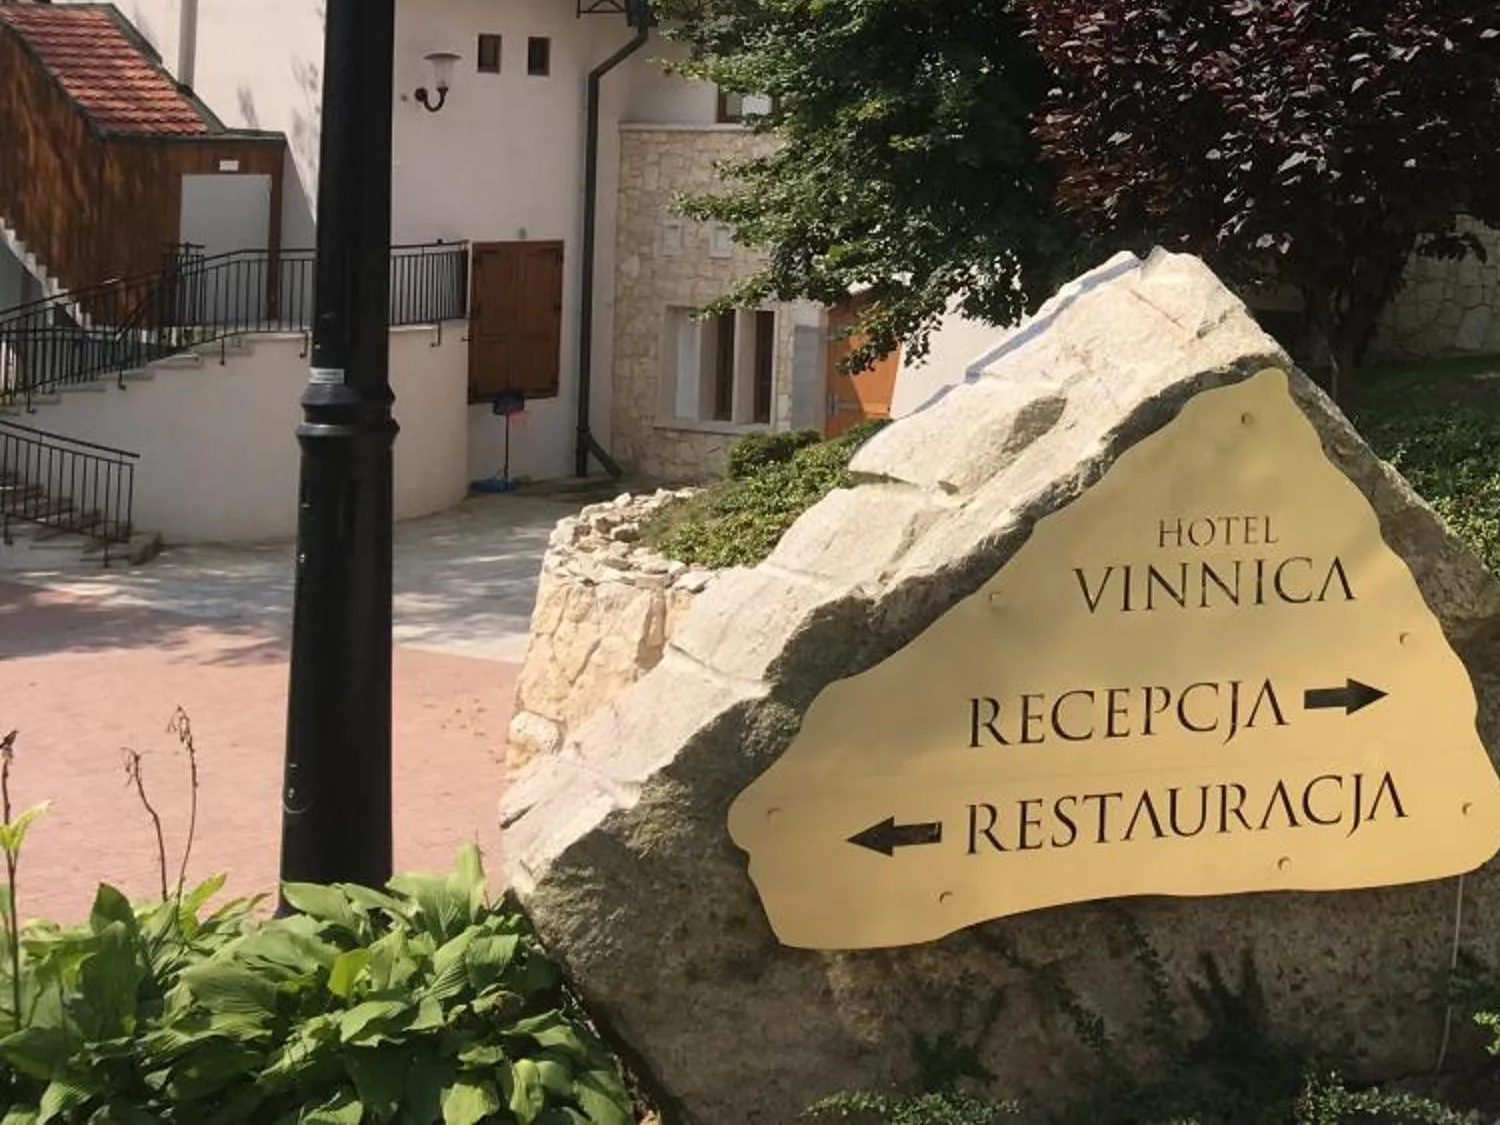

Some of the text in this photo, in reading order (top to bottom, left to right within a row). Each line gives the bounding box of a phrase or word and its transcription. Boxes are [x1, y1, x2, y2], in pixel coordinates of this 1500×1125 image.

[1159, 515, 1279, 548] HOTEL
[1072, 556, 1357, 613] VINNICA
[969, 678, 1290, 748] RECEPCJA
[966, 771, 1408, 856] RESTAURACJA
